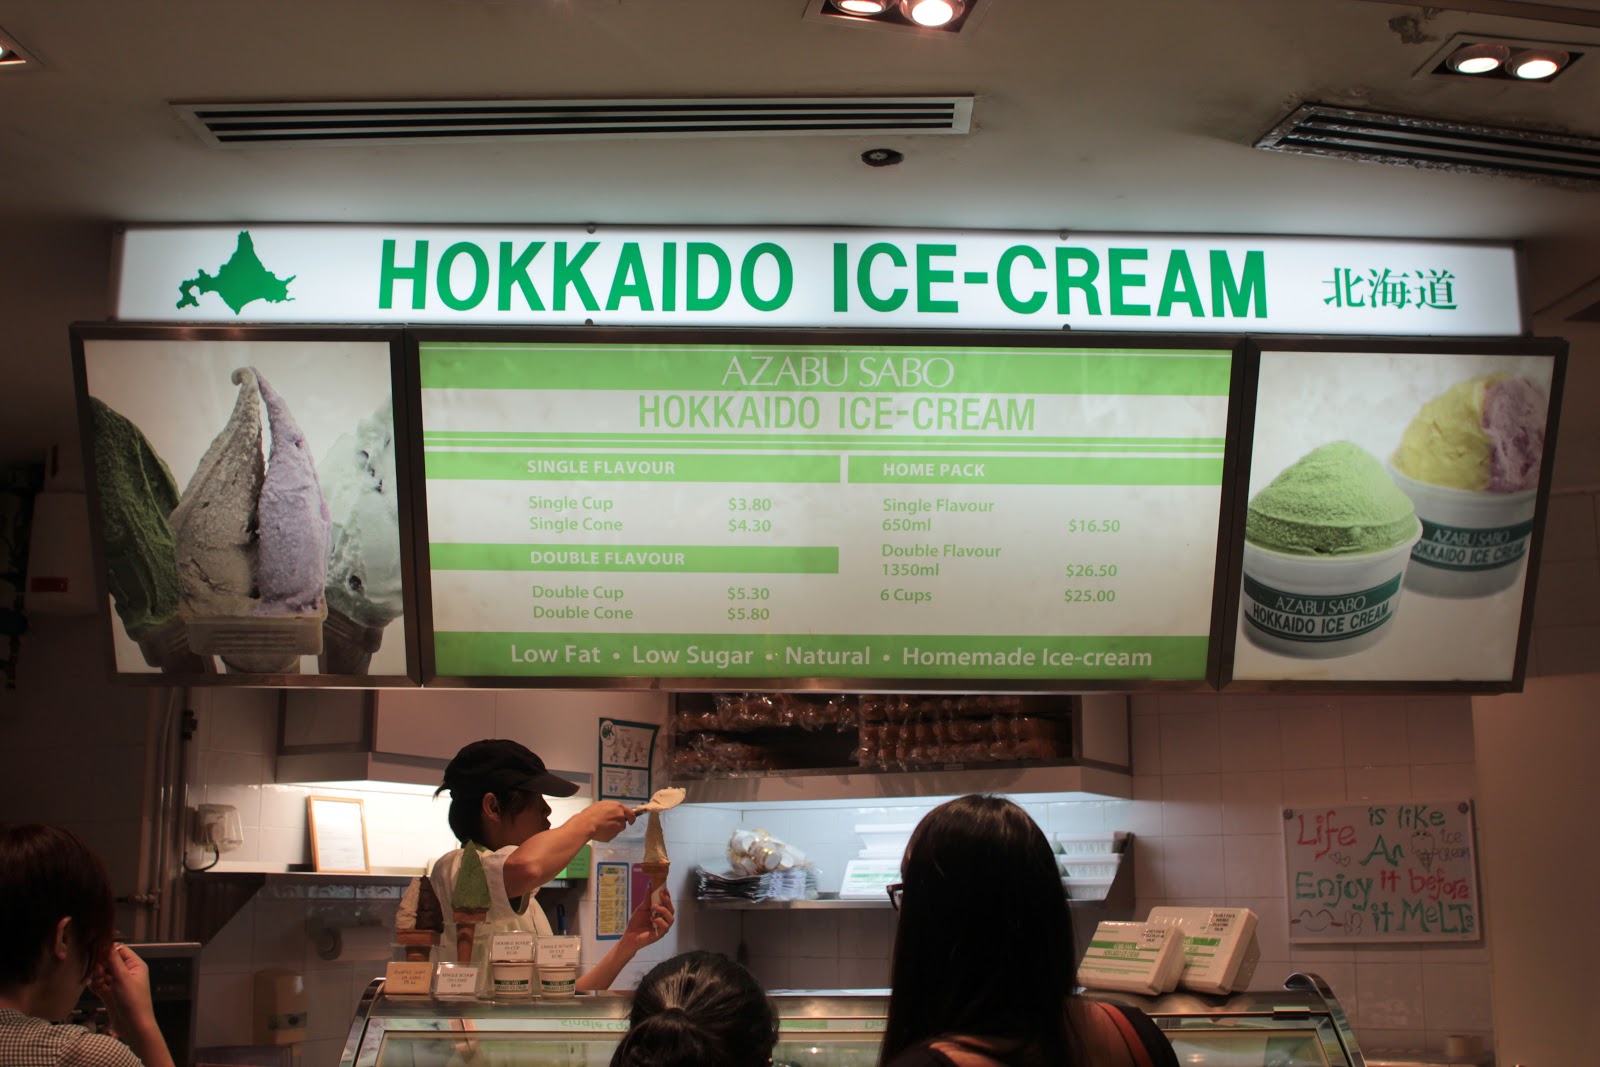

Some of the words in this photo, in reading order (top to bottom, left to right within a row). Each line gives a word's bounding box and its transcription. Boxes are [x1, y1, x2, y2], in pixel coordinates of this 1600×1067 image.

[379, 239, 793, 312] HOKKAIDO
[833, 242, 1267, 318] ICE-CREAM
[1322, 267, 1458, 310] 北海道
[721, 355, 849, 388] AZABU
[858, 357, 955, 388] SABO
[639, 394, 820, 429] HOKKAIDO
[839, 397, 1035, 431] ICE-CREAM
[527, 459, 588, 474] SINGLE
[594, 460, 675, 475] FLAVOUR
[882, 463, 934, 476] HOME
[940, 463, 985, 477] PACK
[528, 495, 578, 512] Single
[581, 496, 614, 513] Cup
[728, 497, 772, 512] $3.80
[883, 498, 932, 515] Single
[936, 498, 995, 512] Flavour
[529, 516, 578, 533] Single
[582, 517, 623, 531] Cone
[728, 518, 772, 533] $4.30
[882, 517, 931, 532] 650ml
[1068, 518, 1121, 533] $16.50
[1432, 529, 1478, 547] AZABU
[530, 551, 599, 565] DOUBLE
[604, 552, 685, 566] FLAVOUR
[882, 543, 939, 558] Double
[943, 544, 1002, 558] Flavour
[1415, 541, 1466, 564] OKKAIDO
[1470, 549, 1491, 564] ICE
[882, 562, 940, 577] 1350ml
[1066, 563, 1118, 578] $26.50
[532, 585, 589, 600] Double
[593, 586, 624, 602] Cup
[727, 586, 770, 602] $5.30
[880, 588, 890, 602] 6
[893, 588, 932, 605] Cups
[1064, 588, 1116, 604] $25.00
[533, 605, 590, 620] Double
[593, 606, 634, 620] Cone
[1275, 596, 1326, 615] AZABU
[1328, 595, 1367, 615] SABO
[727, 607, 770, 622] $5.80
[1253, 603, 1316, 634] HOKKAIDO
[1321, 617, 1345, 635] ICE
[1350, 602, 1390, 630] CREAM
[511, 644, 558, 664] Low
[565, 644, 601, 664] Fat
[633, 645, 680, 665] Low
[686, 645, 754, 669] Sugar
[785, 645, 871, 666] Natural
[903, 647, 1035, 667] Homemade
[1042, 648, 1153, 667] Ice-cream
[1297, 810, 1358, 861] Life
[1367, 806, 1387, 826] is
[1359, 834, 1405, 867] An
[1295, 871, 1374, 912] Enjoy
[1380, 869, 1402, 893] it
[1407, 867, 1471, 901] before
[1370, 901, 1394, 933] it
